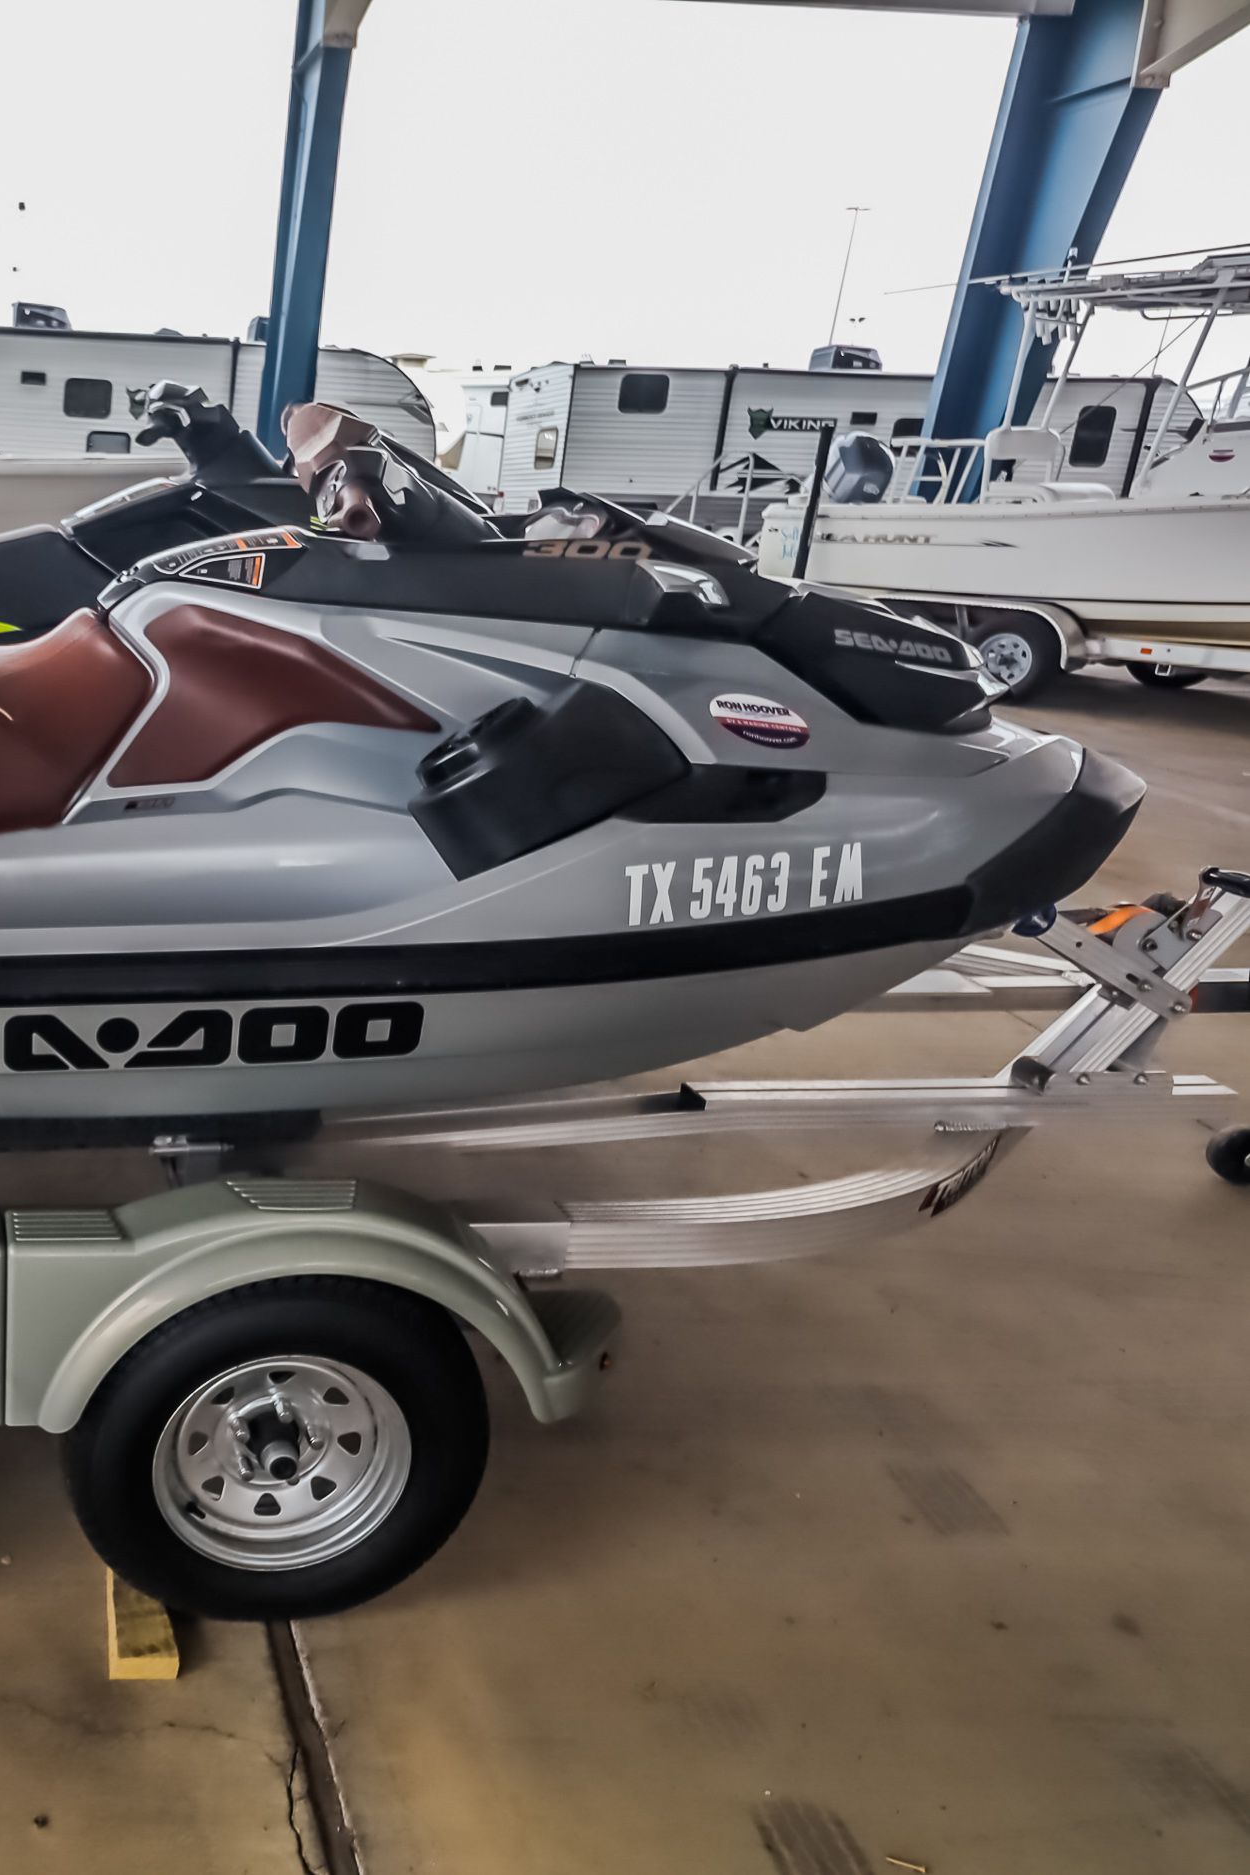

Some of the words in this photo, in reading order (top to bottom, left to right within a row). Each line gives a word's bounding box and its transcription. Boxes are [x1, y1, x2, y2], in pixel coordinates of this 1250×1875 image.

[522, 540, 653, 560] 300
[715, 699, 742, 712] RON
[743, 703, 792, 717] HOOVER
[624, 861, 677, 927] TX
[689, 851, 791, 920] 5463
